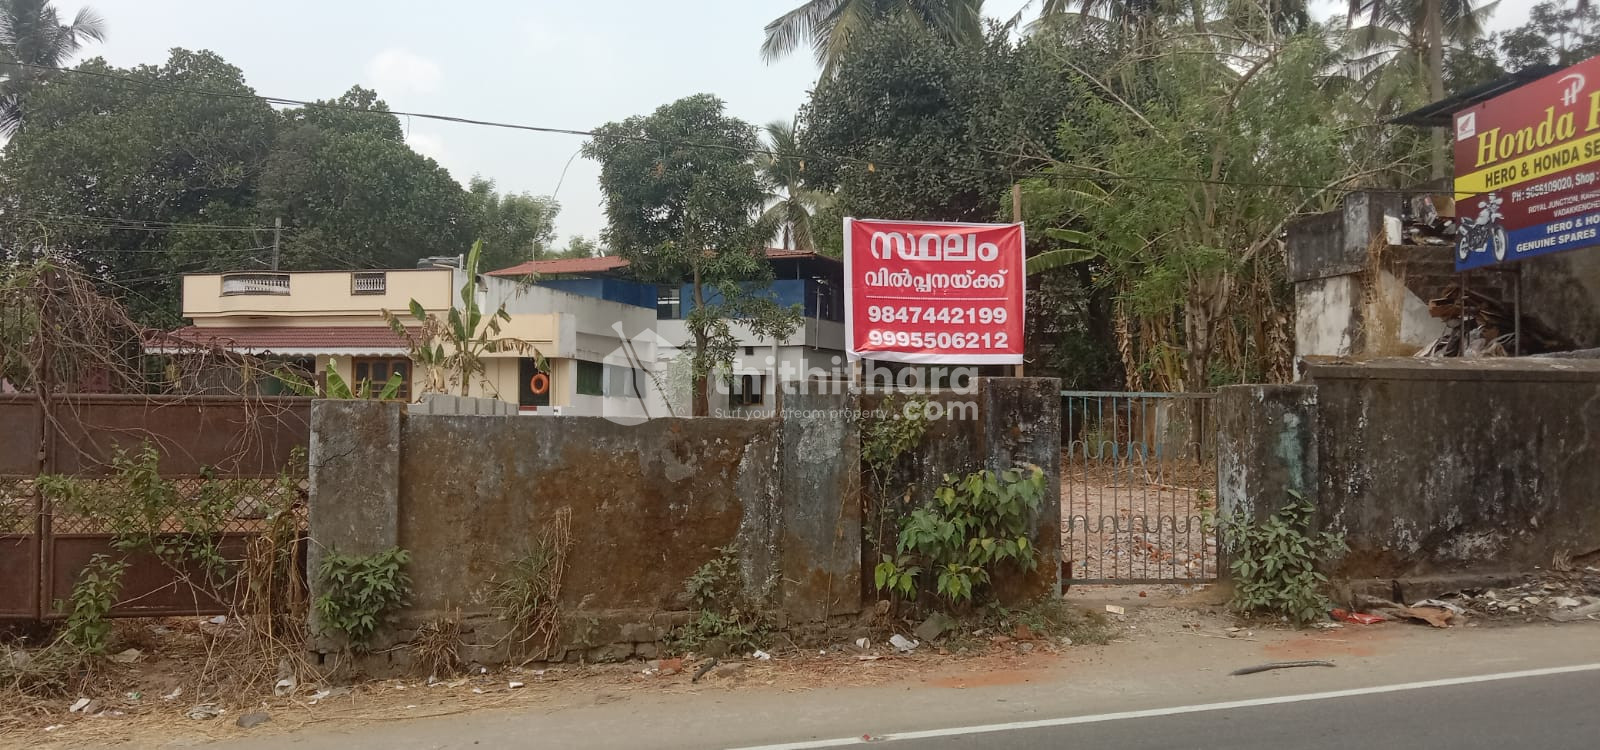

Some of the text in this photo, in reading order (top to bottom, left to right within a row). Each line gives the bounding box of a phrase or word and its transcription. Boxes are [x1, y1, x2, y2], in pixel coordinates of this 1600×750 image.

[1475, 106, 1576, 168] Honda
[1485, 165, 1516, 188] HERO
[1520, 161, 1529, 177] &
[1533, 145, 1579, 174] HONDA
[1528, 203, 1547, 214] ROYAL
[1546, 220, 1573, 234] HERO
[1575, 217, 1583, 228] &
[1516, 228, 1596, 253] GENUINE SPARES
[868, 305, 1008, 324] 9847442199
[868, 330, 1009, 349] 9995506212
